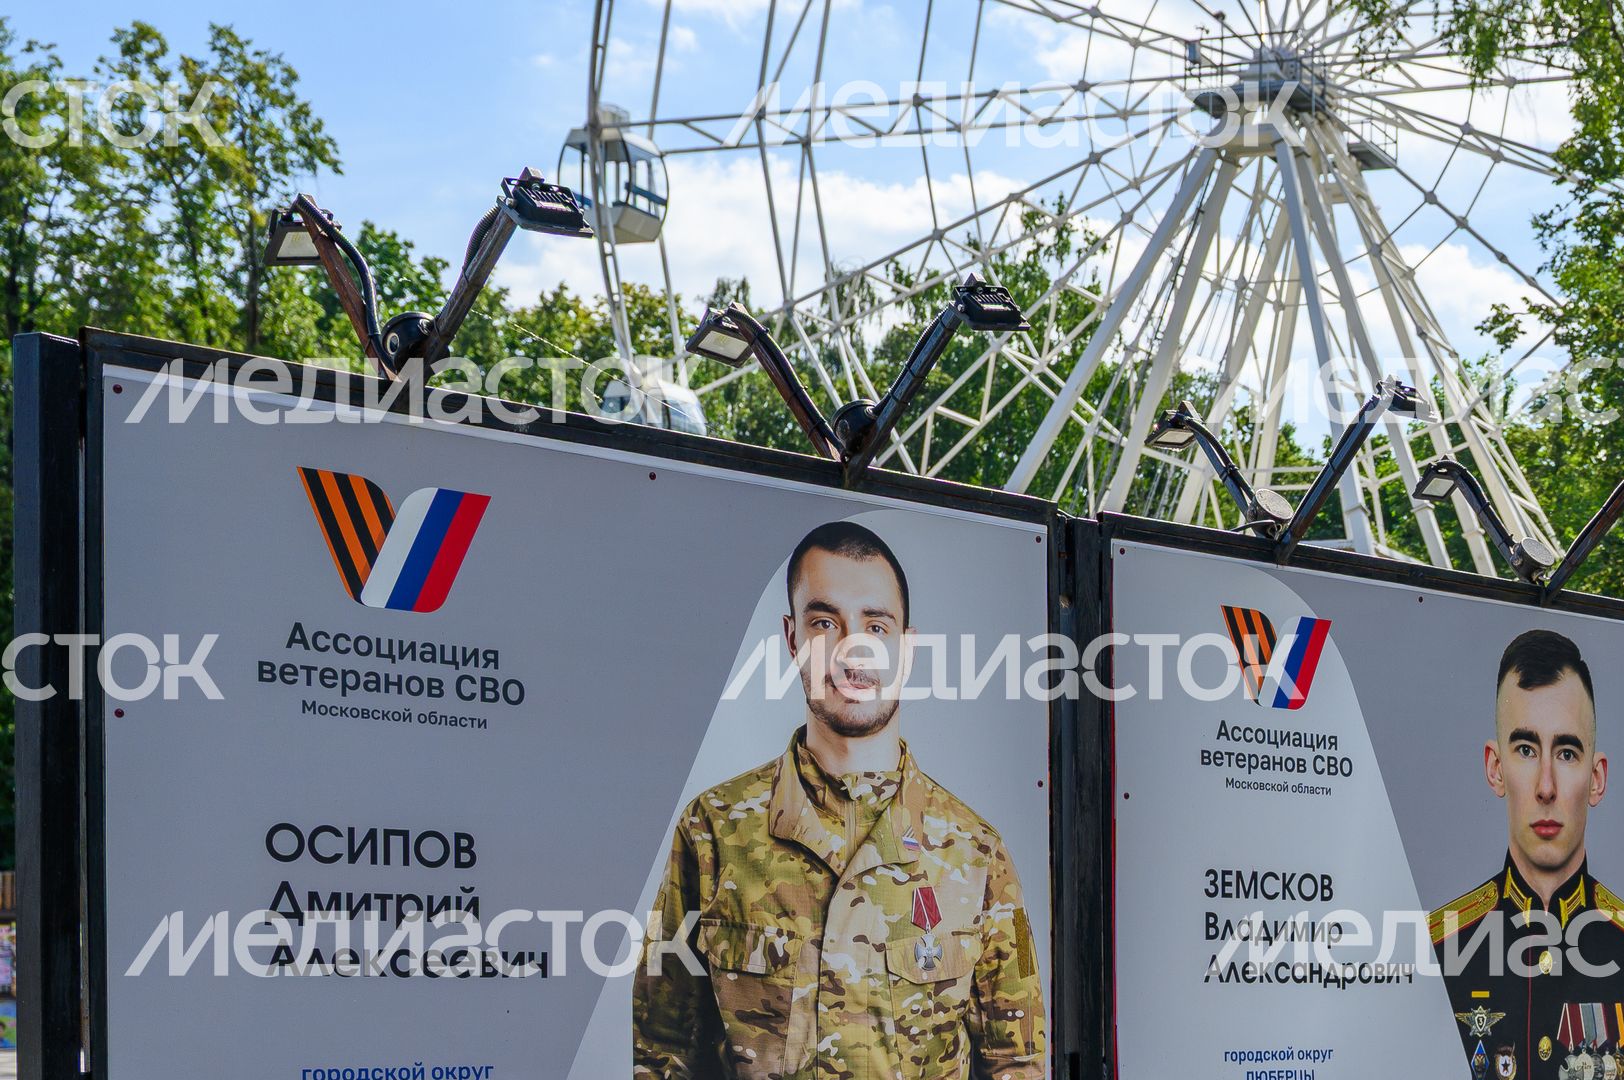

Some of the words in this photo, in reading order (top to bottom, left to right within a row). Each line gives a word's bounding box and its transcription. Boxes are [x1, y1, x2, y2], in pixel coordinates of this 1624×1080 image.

[285, 621, 500, 670] Ассоциация
[257, 660, 445, 698] ветеранов
[455, 674, 526, 706] СВО
[301, 699, 413, 723] Московской
[417, 711, 488, 730] области
[1216, 720, 1338, 752] Ассоциация
[1200, 749, 1307, 774] ветеранов
[1312, 755, 1353, 777] СВО
[1225, 777, 1289, 793] Московской
[1291, 782, 1332, 796] области
[264, 822, 478, 870] ОСИПОВ
[1204, 868, 1334, 902] ЗЕМСКОВ
[264, 880, 481, 931] Дмитрий
[1204, 911, 1343, 949] Владимир
[265, 938, 549, 979] Алексеевич
[1204, 954, 1414, 990] Александрович
[1224, 1046, 1294, 1065] городской
[1297, 1048, 1334, 1064] округ
